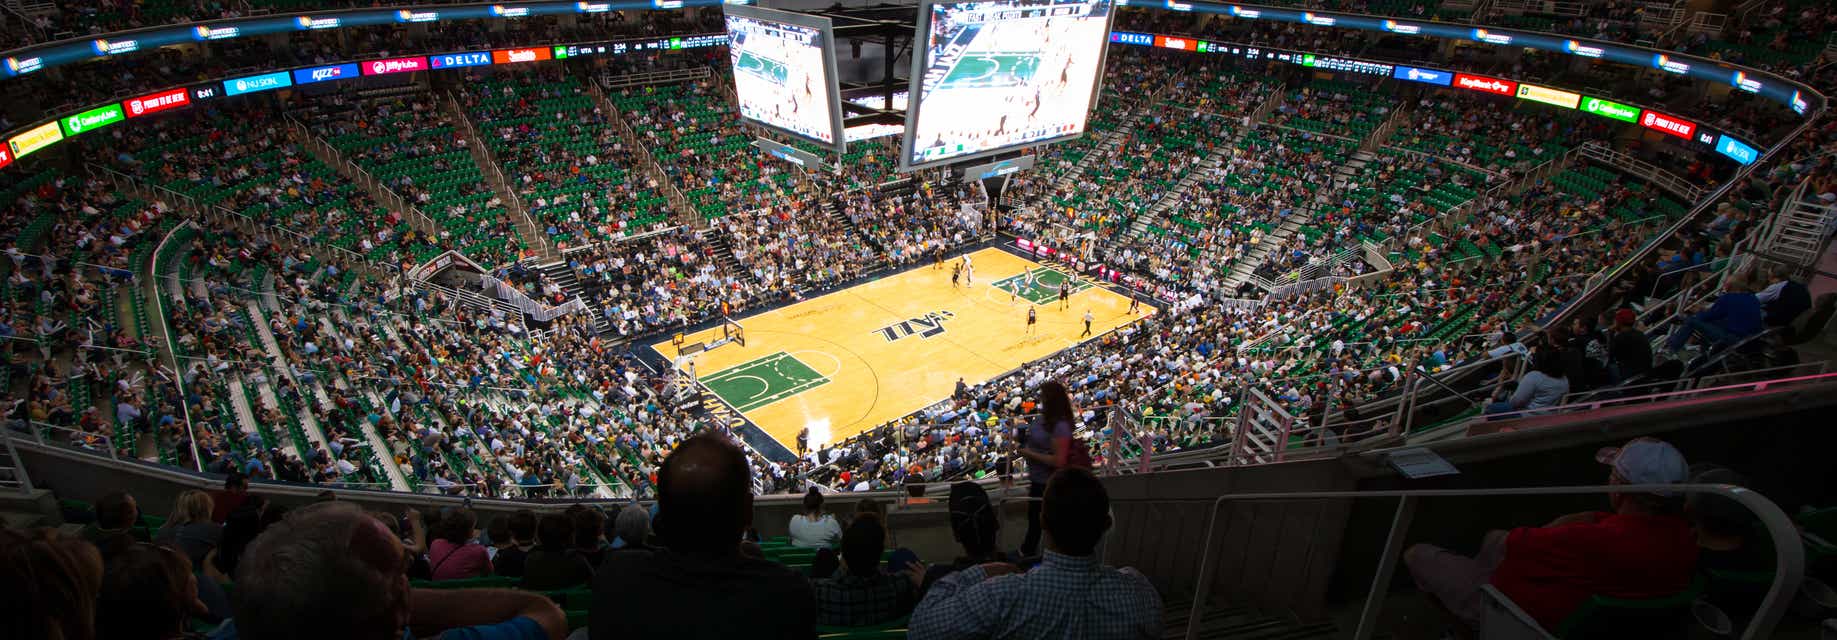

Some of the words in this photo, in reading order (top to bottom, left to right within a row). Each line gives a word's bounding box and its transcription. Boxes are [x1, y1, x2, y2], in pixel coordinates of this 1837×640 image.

[1121, 34, 1151, 44] DELTA
[445, 54, 489, 66] DELTA
[246, 80, 258, 88] NU
[1460, 77, 1492, 90] KeyBank
[80, 110, 118, 126] CenturyLink
